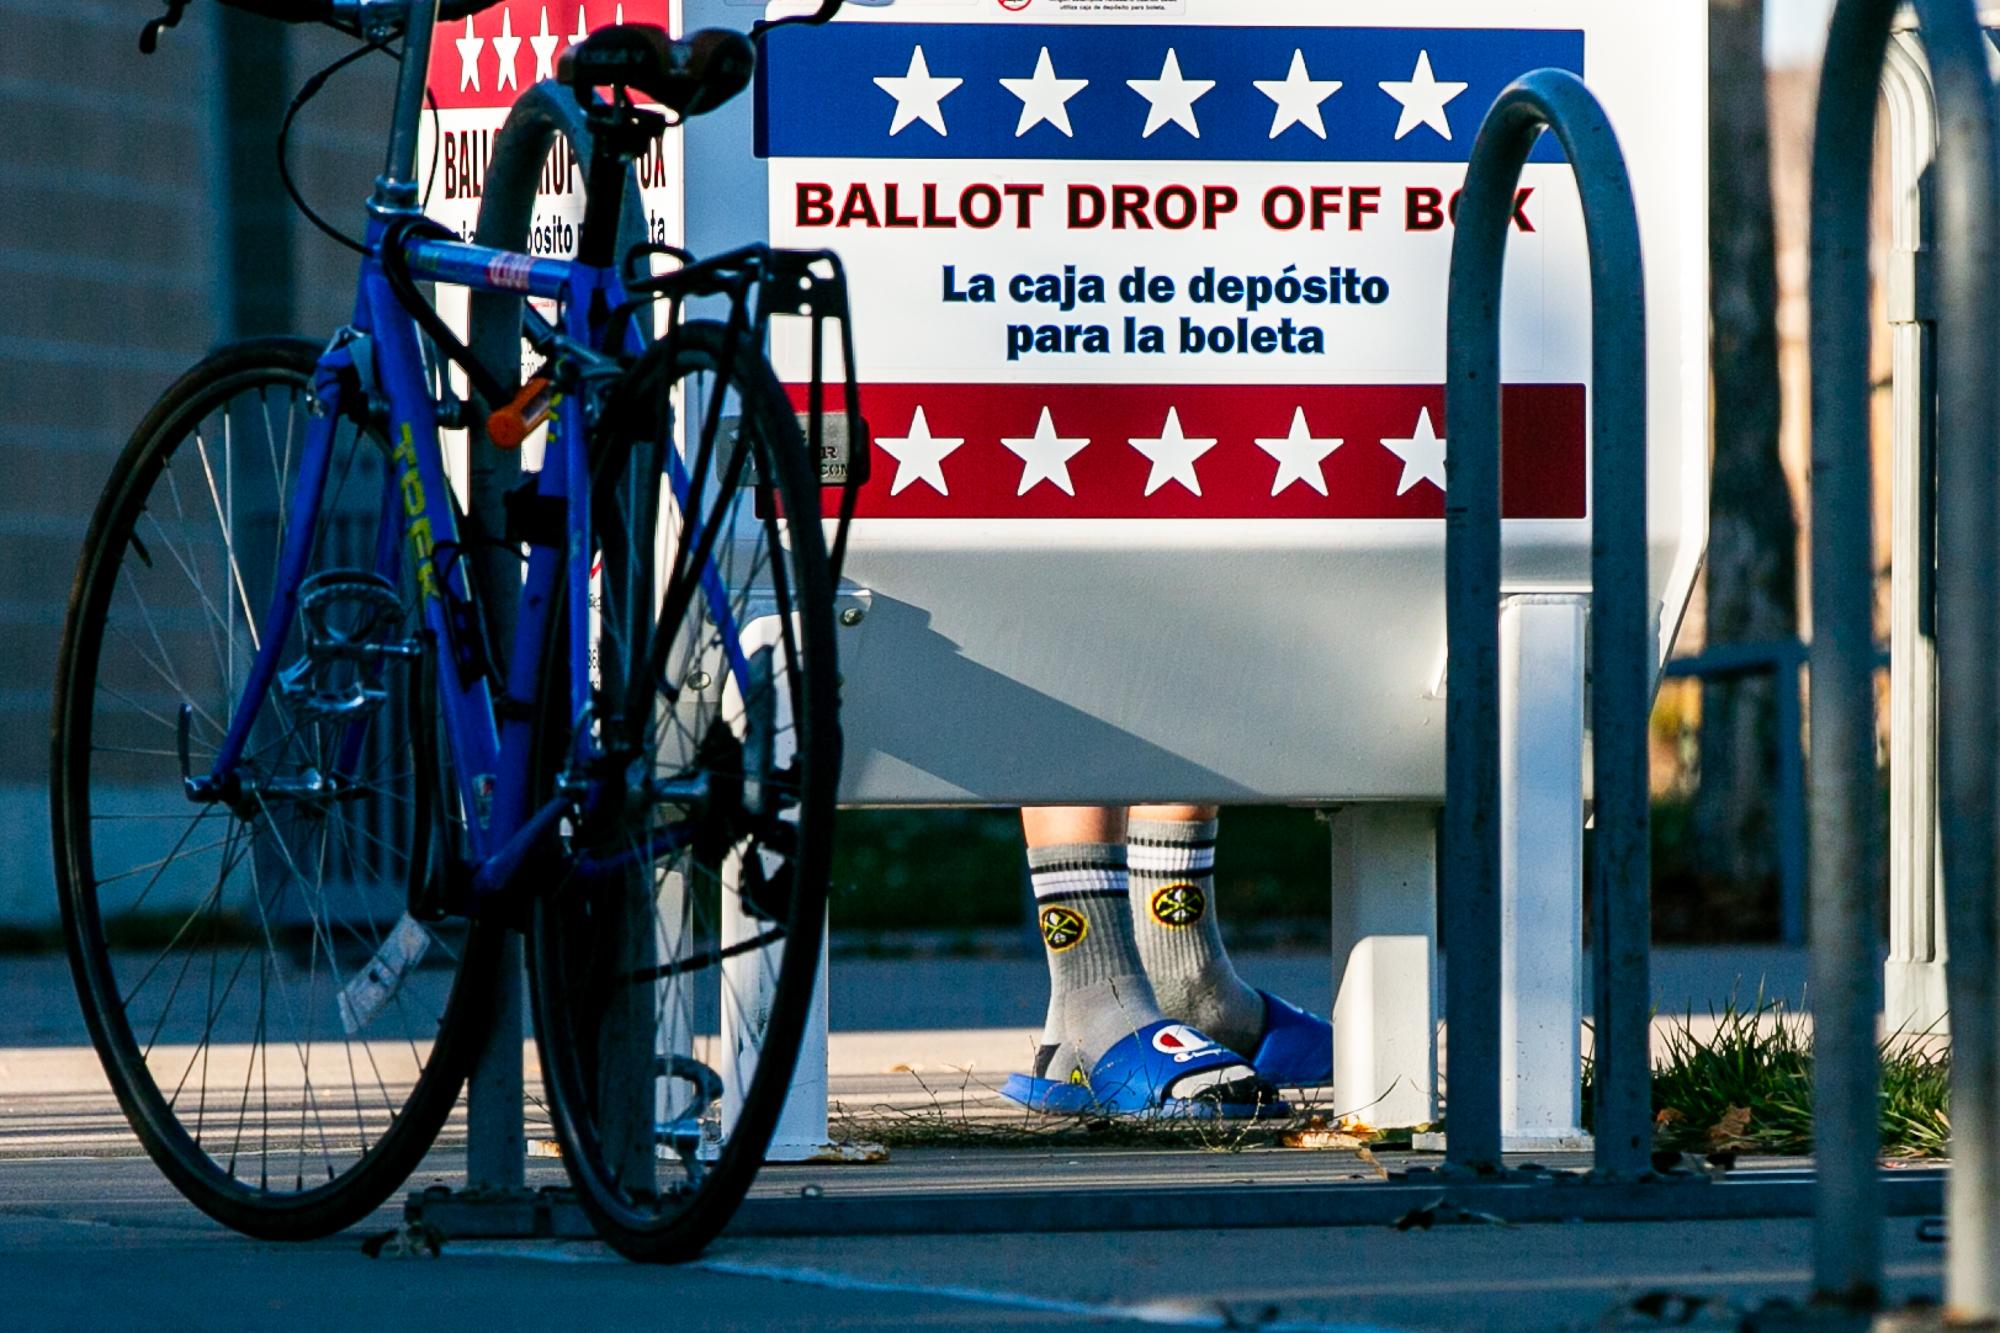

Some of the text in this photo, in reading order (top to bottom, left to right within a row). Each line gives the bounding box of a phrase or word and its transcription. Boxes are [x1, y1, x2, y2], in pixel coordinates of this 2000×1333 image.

[795, 182, 1045, 229] BALLOT
[1067, 183, 1238, 230] DROP
[1261, 184, 1381, 231] OFF
[942, 263, 1390, 311] La caja de depósito
[1006, 316, 1325, 361] para la boleta
